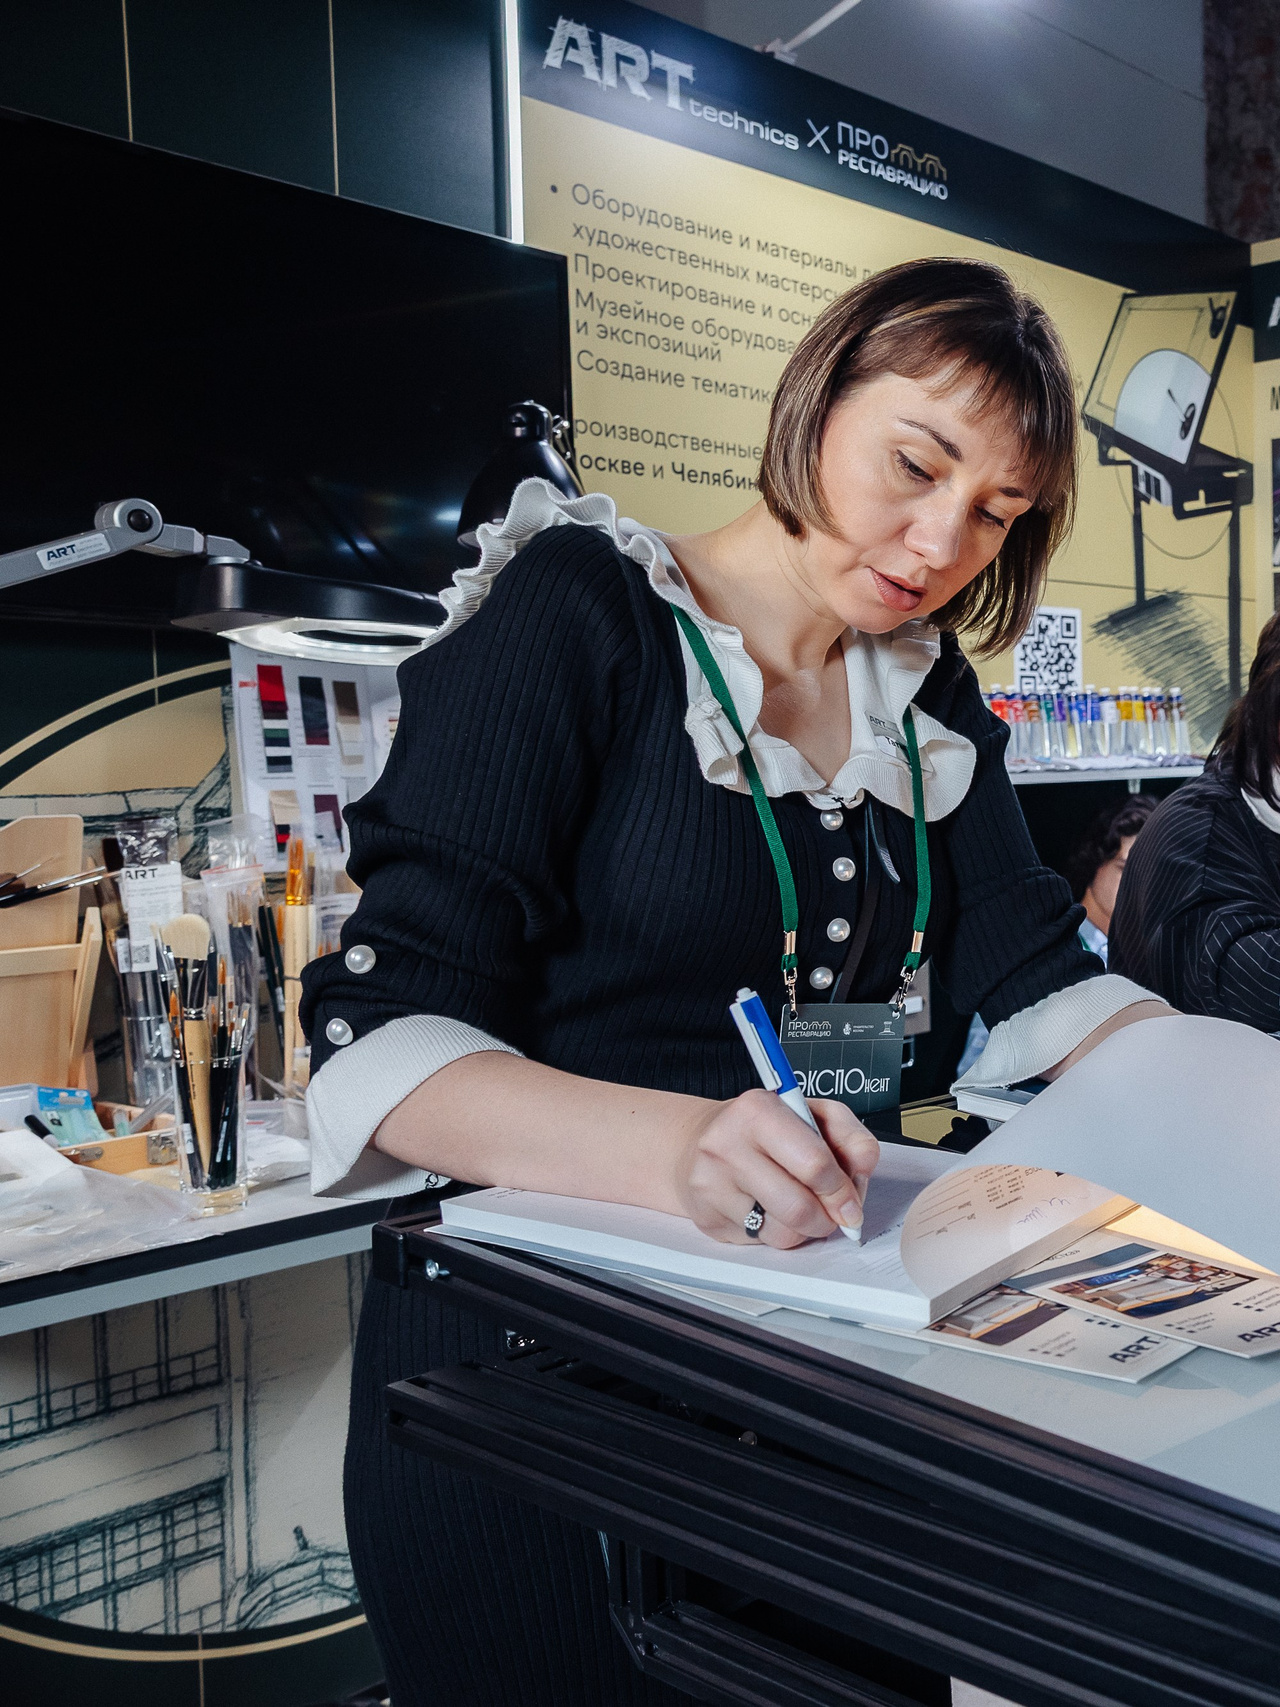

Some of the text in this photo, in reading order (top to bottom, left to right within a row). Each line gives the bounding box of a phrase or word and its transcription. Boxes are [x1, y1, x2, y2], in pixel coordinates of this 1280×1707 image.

[542, 15, 695, 112] ART
[688, 98, 800, 151] technics
[837, 121, 890, 160] ПРО
[837, 150, 948, 200] РЕСТАВРАЦИЮ
[571, 183, 857, 279] Оборудование и материалы
[572, 222, 751, 282] художественных
[573, 253, 756, 316] Проектирование
[762, 304, 772, 318] и
[575, 289, 685, 331] Музейное
[576, 320, 722, 362] и экспозиций
[576, 350, 685, 390] Создание
[574, 418, 764, 461] роизводственные
[579, 453, 758, 491] оскве и Челябин
[47, 544, 76, 561] ART
[125, 868, 158, 880] ART
[788, 1021, 809, 1031] ПРО
[788, 1030, 831, 1038] РЕСТАВРАЦИЮ
[1109, 1335, 1160, 1363] ART
